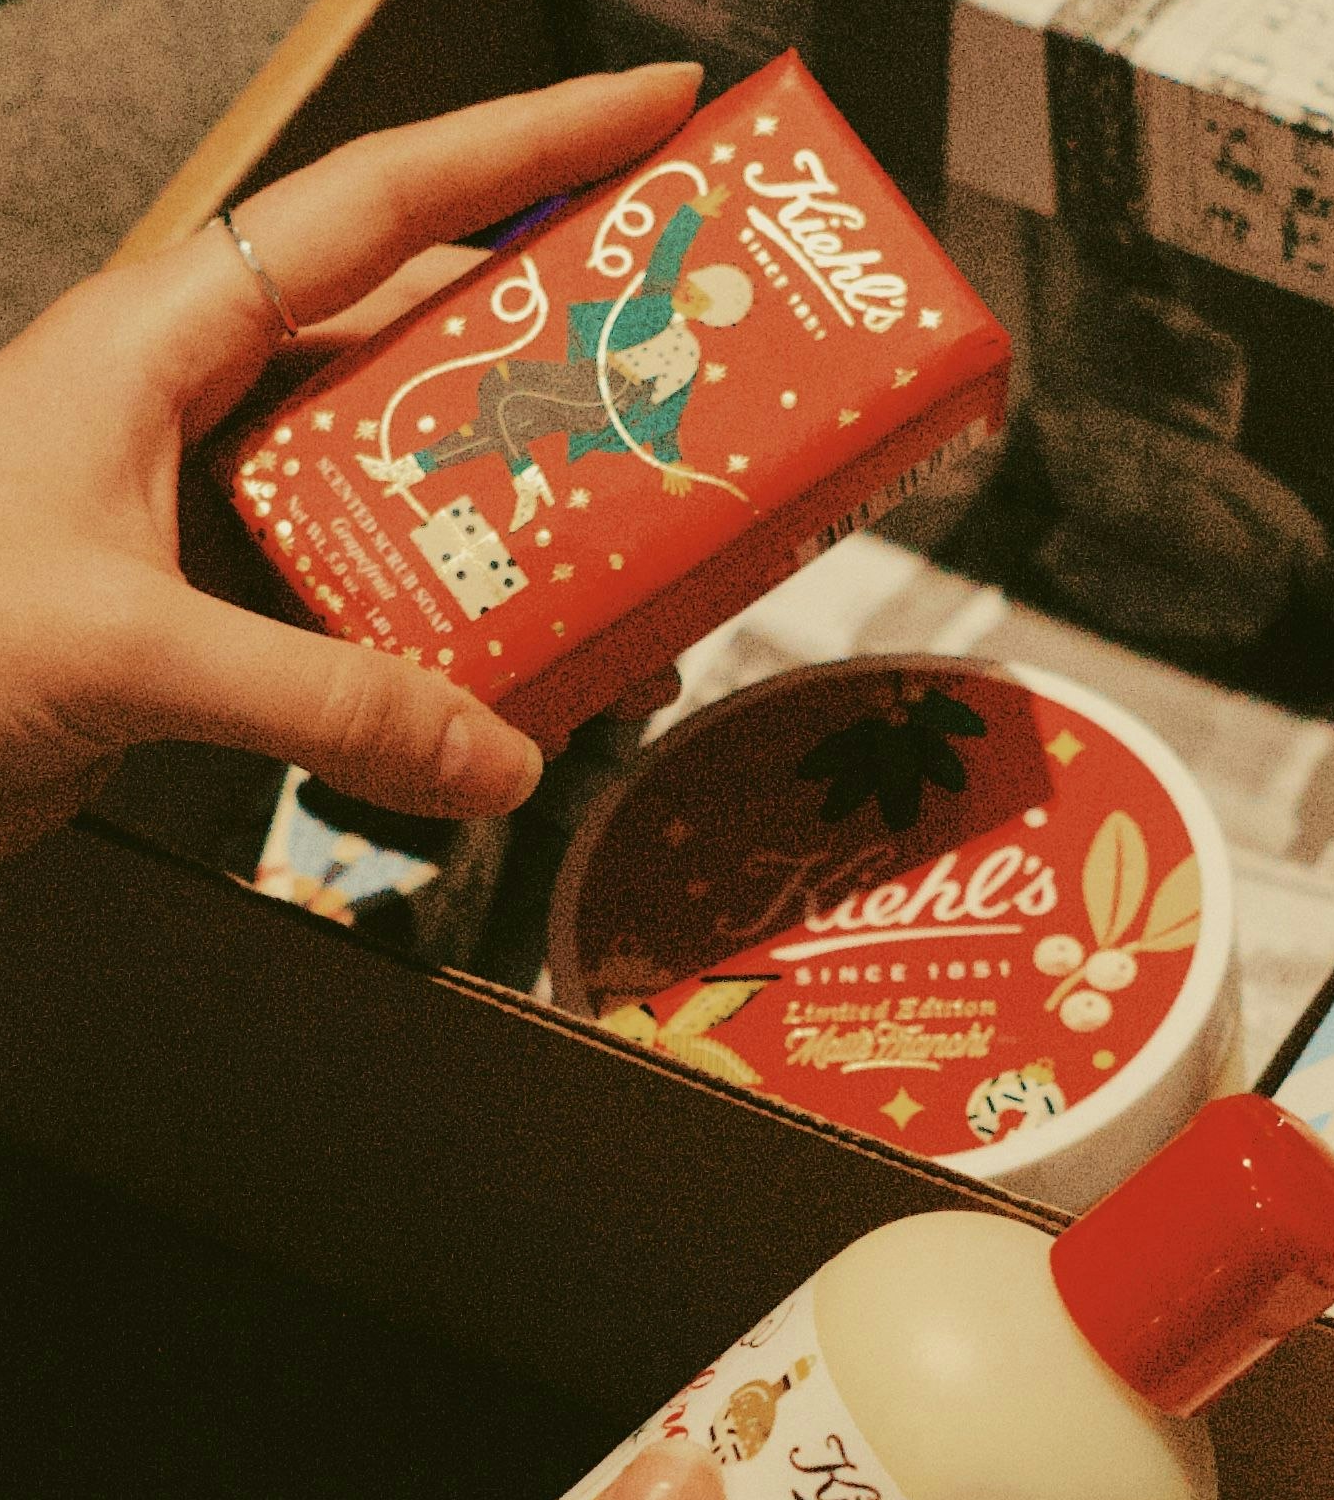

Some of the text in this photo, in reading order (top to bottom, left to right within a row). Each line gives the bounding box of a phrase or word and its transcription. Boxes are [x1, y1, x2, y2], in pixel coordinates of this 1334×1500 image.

[739, 227, 790, 290] SINCE
[743, 149, 908, 334] Kiehl's
[317, 456, 454, 634] SCENTED SCRUB SOAP
[330, 517, 398, 601] Grapefruit
[366, 606, 393, 637] 140
[715, 842, 1059, 936] Kiehl's
[794, 958, 1011, 987] SINCE 1851
[781, 996, 998, 1025] Limited Edition
